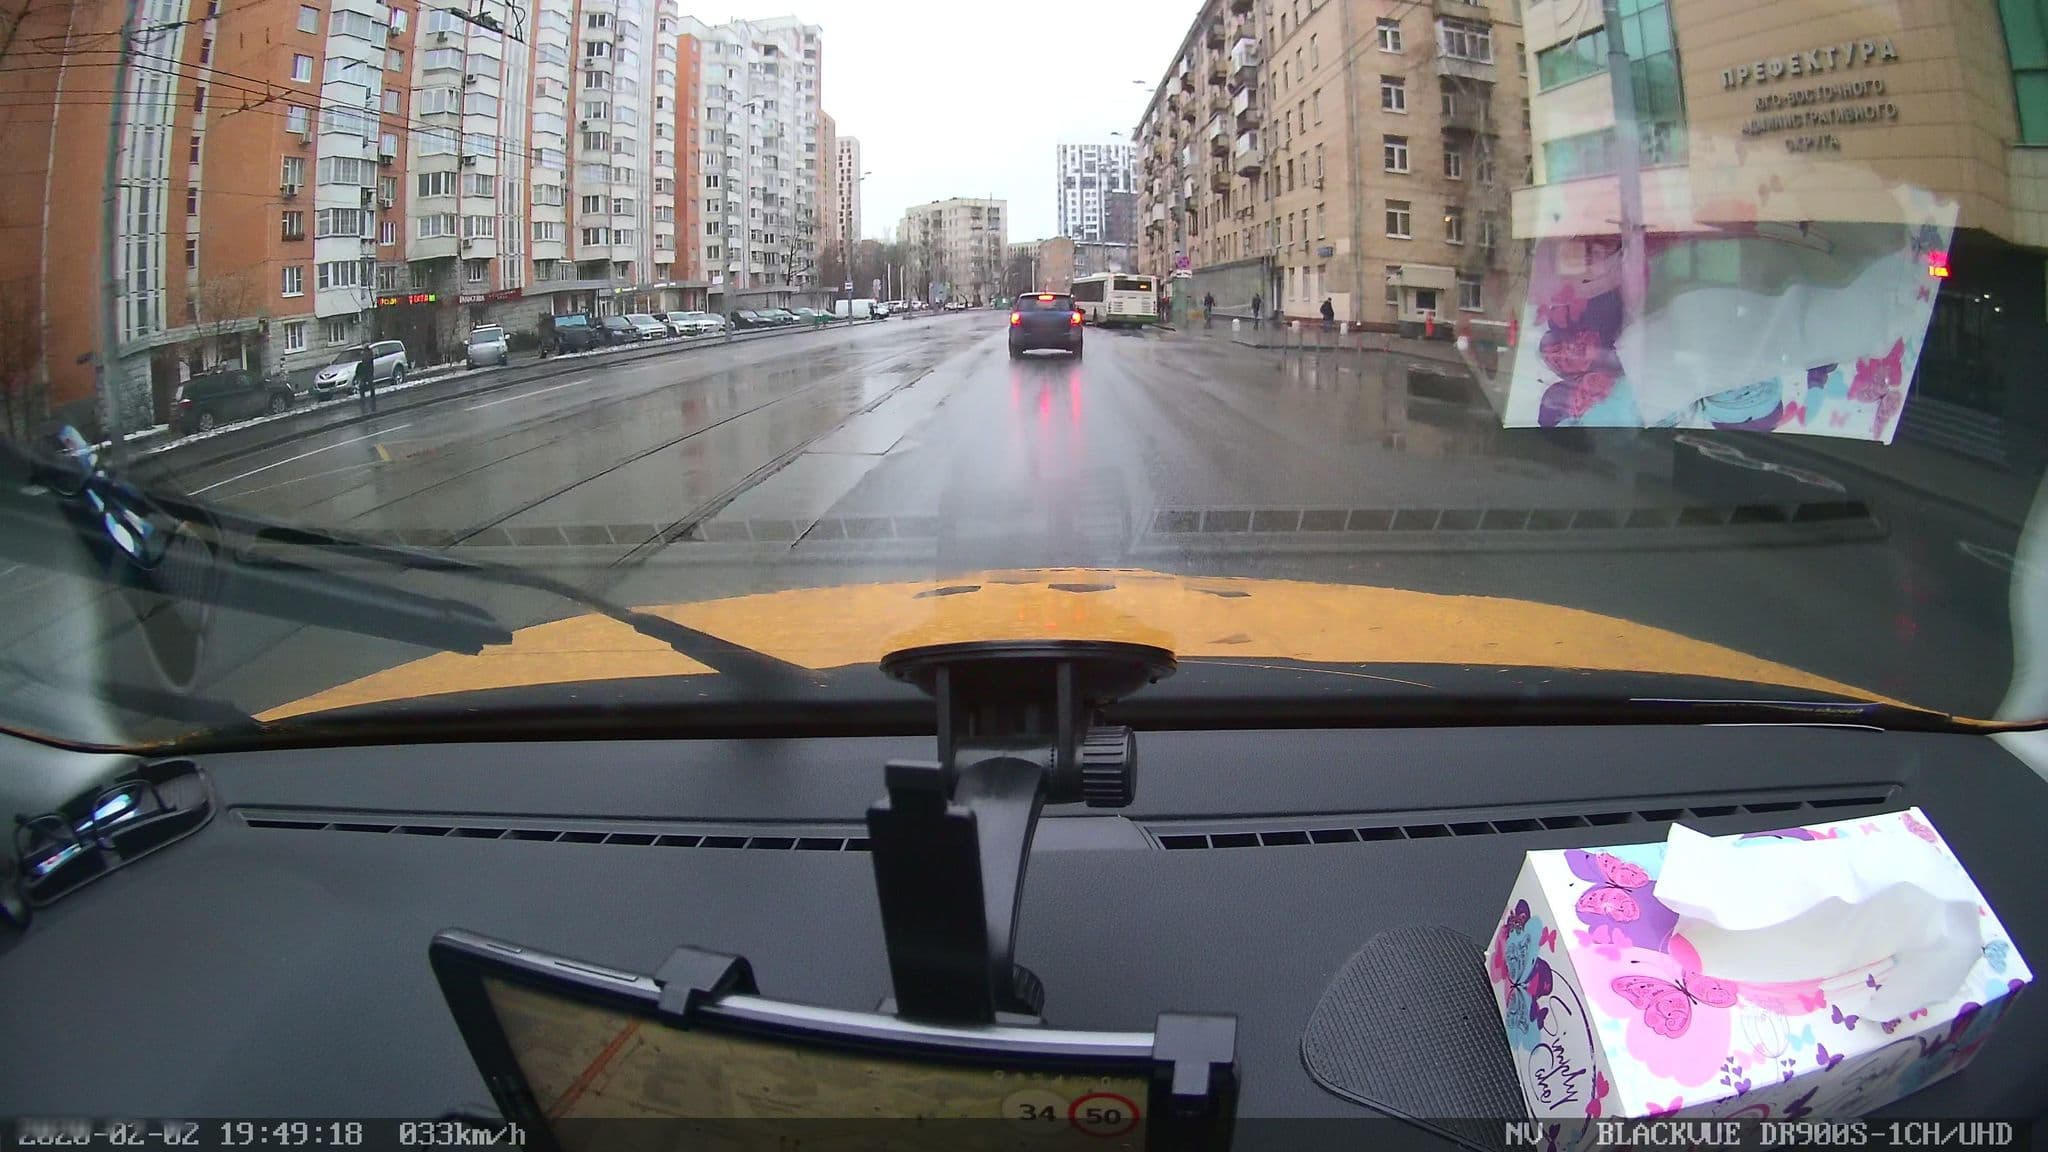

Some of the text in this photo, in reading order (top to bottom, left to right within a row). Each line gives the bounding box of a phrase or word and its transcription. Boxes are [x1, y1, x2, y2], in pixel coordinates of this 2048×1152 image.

[1720, 38, 1899, 90] ПРЕФЕКТУРА
[1754, 80, 1886, 113] ЮГО-ВОСТОЧНОГО
[1542, 995, 1587, 1111] Simply
[1019, 1104, 1056, 1122] 34
[1086, 1108, 1121, 1125] 50
